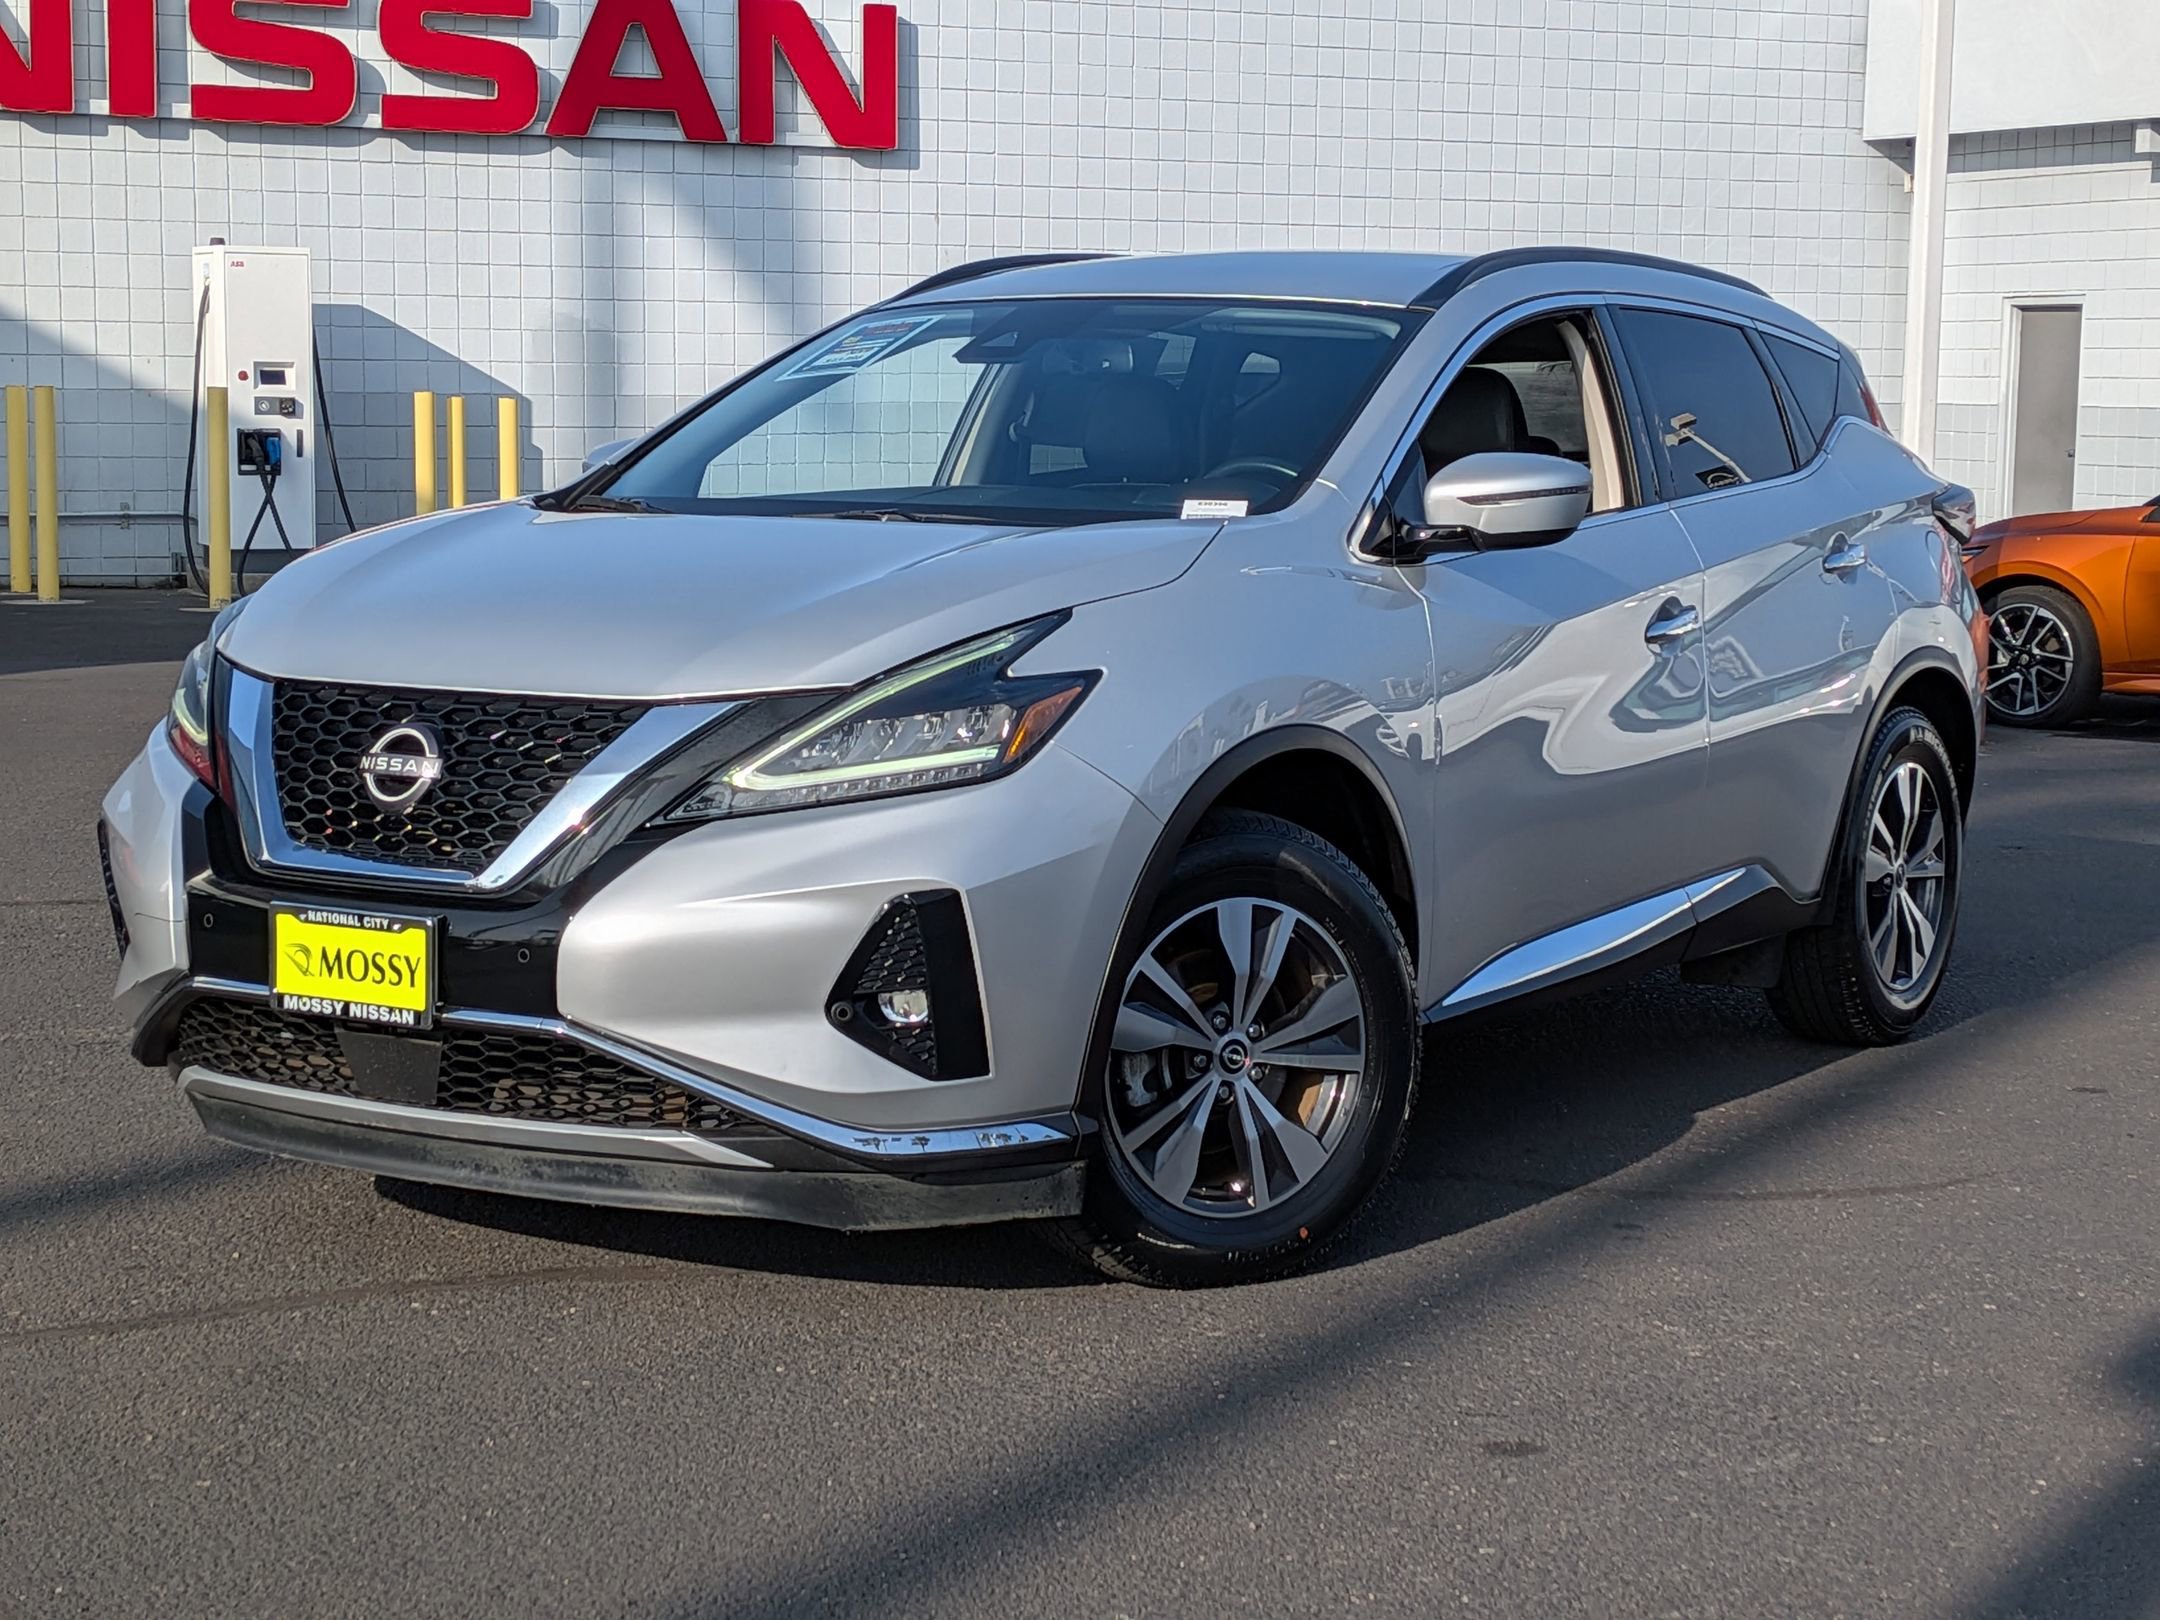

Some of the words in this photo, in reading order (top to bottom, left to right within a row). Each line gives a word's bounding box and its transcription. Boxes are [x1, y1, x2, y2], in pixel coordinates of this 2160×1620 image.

[360, 756, 439, 775] NISSAN
[308, 910, 360, 927] NATIONAL
[363, 916, 389, 930] CITY
[319, 946, 421, 988] MOSSY
[283, 994, 345, 1015] MOSSY
[350, 1003, 414, 1025] NISSAN
